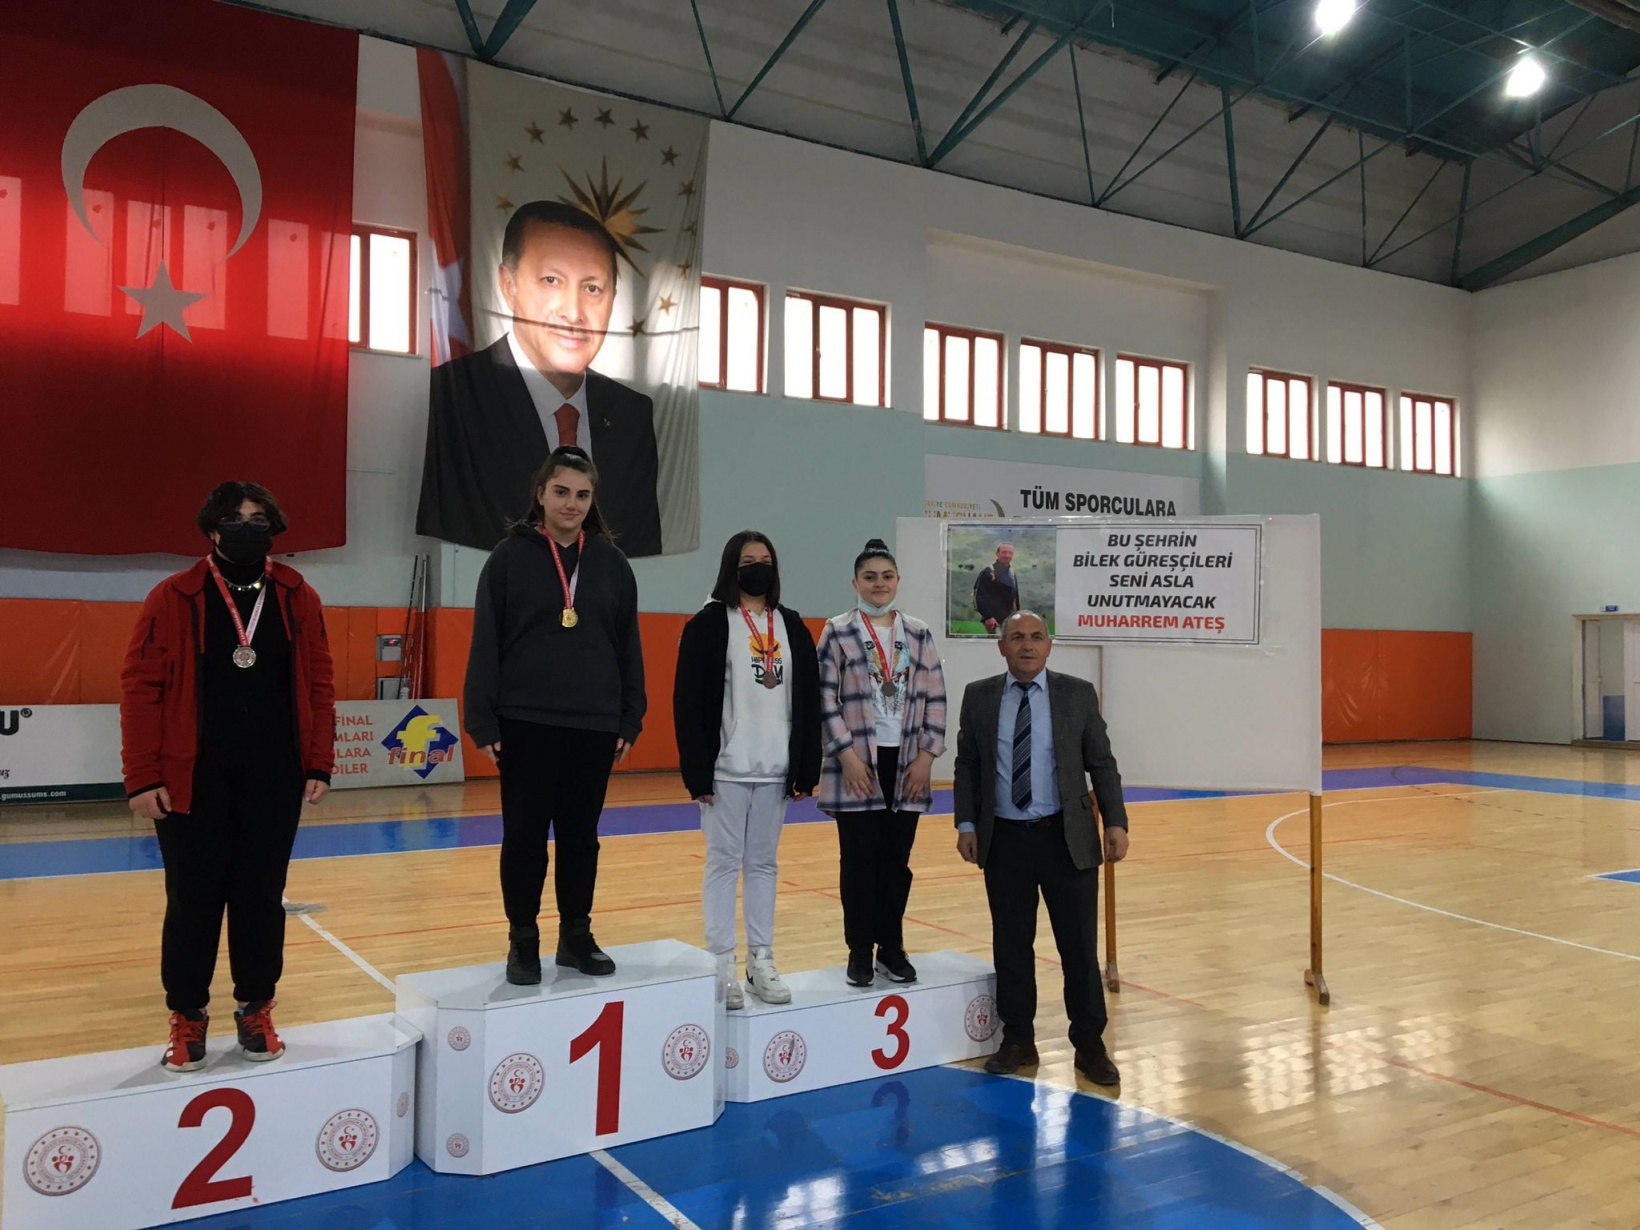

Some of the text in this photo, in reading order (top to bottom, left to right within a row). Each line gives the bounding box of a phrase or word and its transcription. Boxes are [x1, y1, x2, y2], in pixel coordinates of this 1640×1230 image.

[1020, 485, 1176, 517] TÜM SPORCULARA
[1107, 531, 1197, 551] BU ŞEHRİN
[1073, 551, 1233, 572] BİLEK GÜREŞÇİLERİ
[1109, 571, 1194, 588] SENİ ASLA
[1087, 594, 1217, 609] UNUTMAYACAK
[1078, 614, 1225, 634] MUHARREM ATEŞ
[388, 744, 455, 765] final
[871, 994, 910, 1070] 3
[569, 1001, 624, 1136] 1
[171, 1087, 256, 1210] 2
